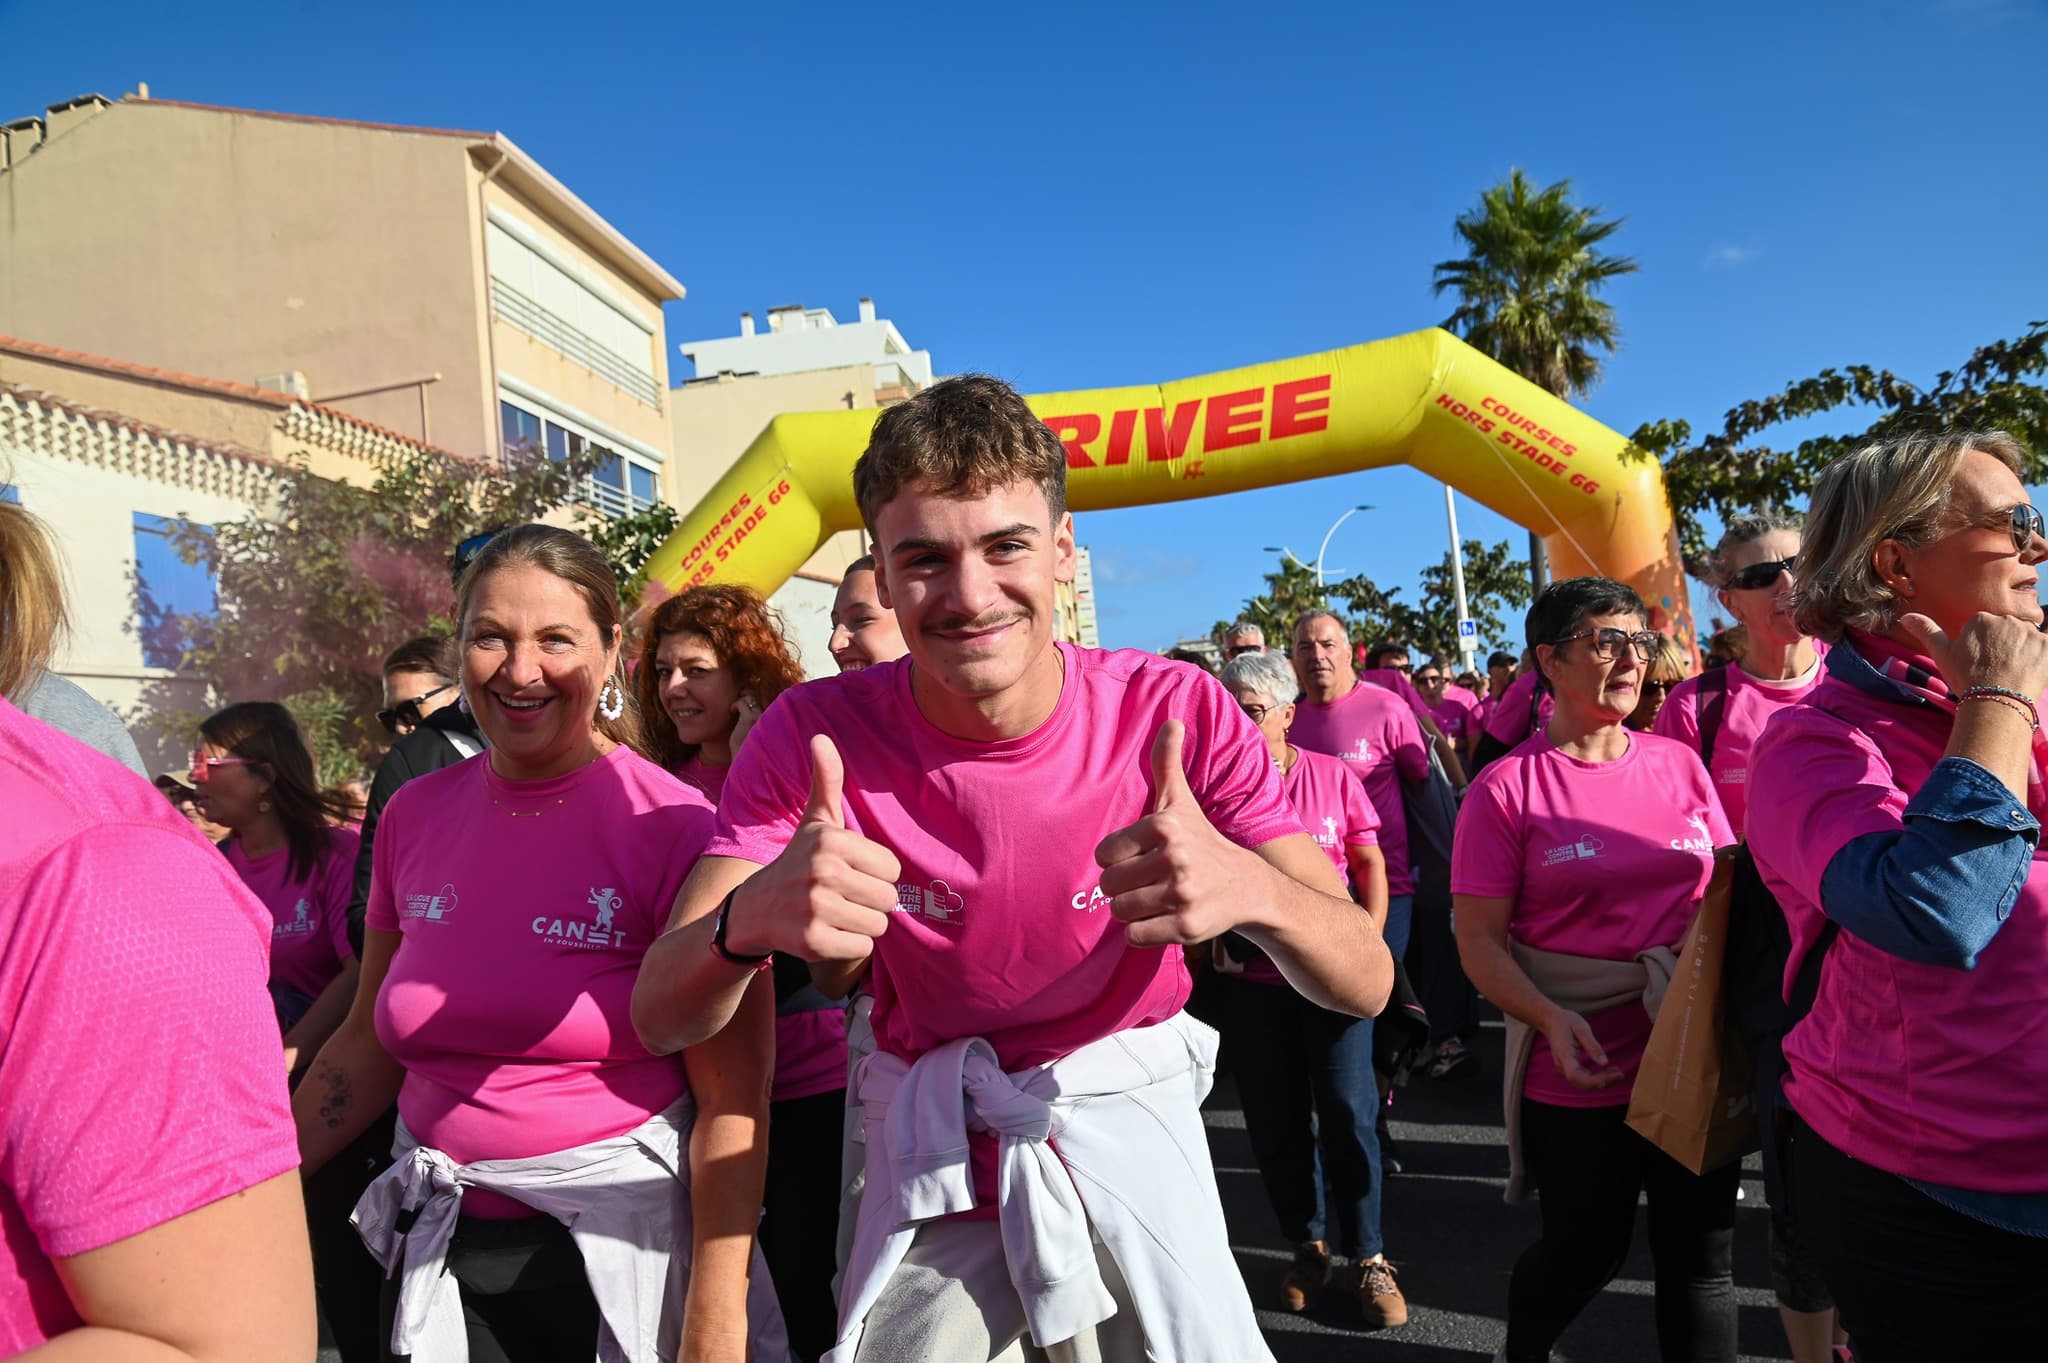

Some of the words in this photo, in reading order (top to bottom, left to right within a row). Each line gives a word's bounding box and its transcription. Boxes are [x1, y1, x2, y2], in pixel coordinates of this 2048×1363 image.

[1042, 374, 1331, 469] RIVEE
[1436, 393, 1497, 433] HORS
[1497, 430, 1568, 477] STADE
[1569, 473, 1600, 496] 66
[1480, 396, 1578, 457] COURSES
[681, 493, 751, 571] COURSES
[715, 505, 767, 561] STADE
[768, 479, 790, 505] 66
[898, 884, 921, 894] IGUE
[532, 917, 627, 948] CANET
